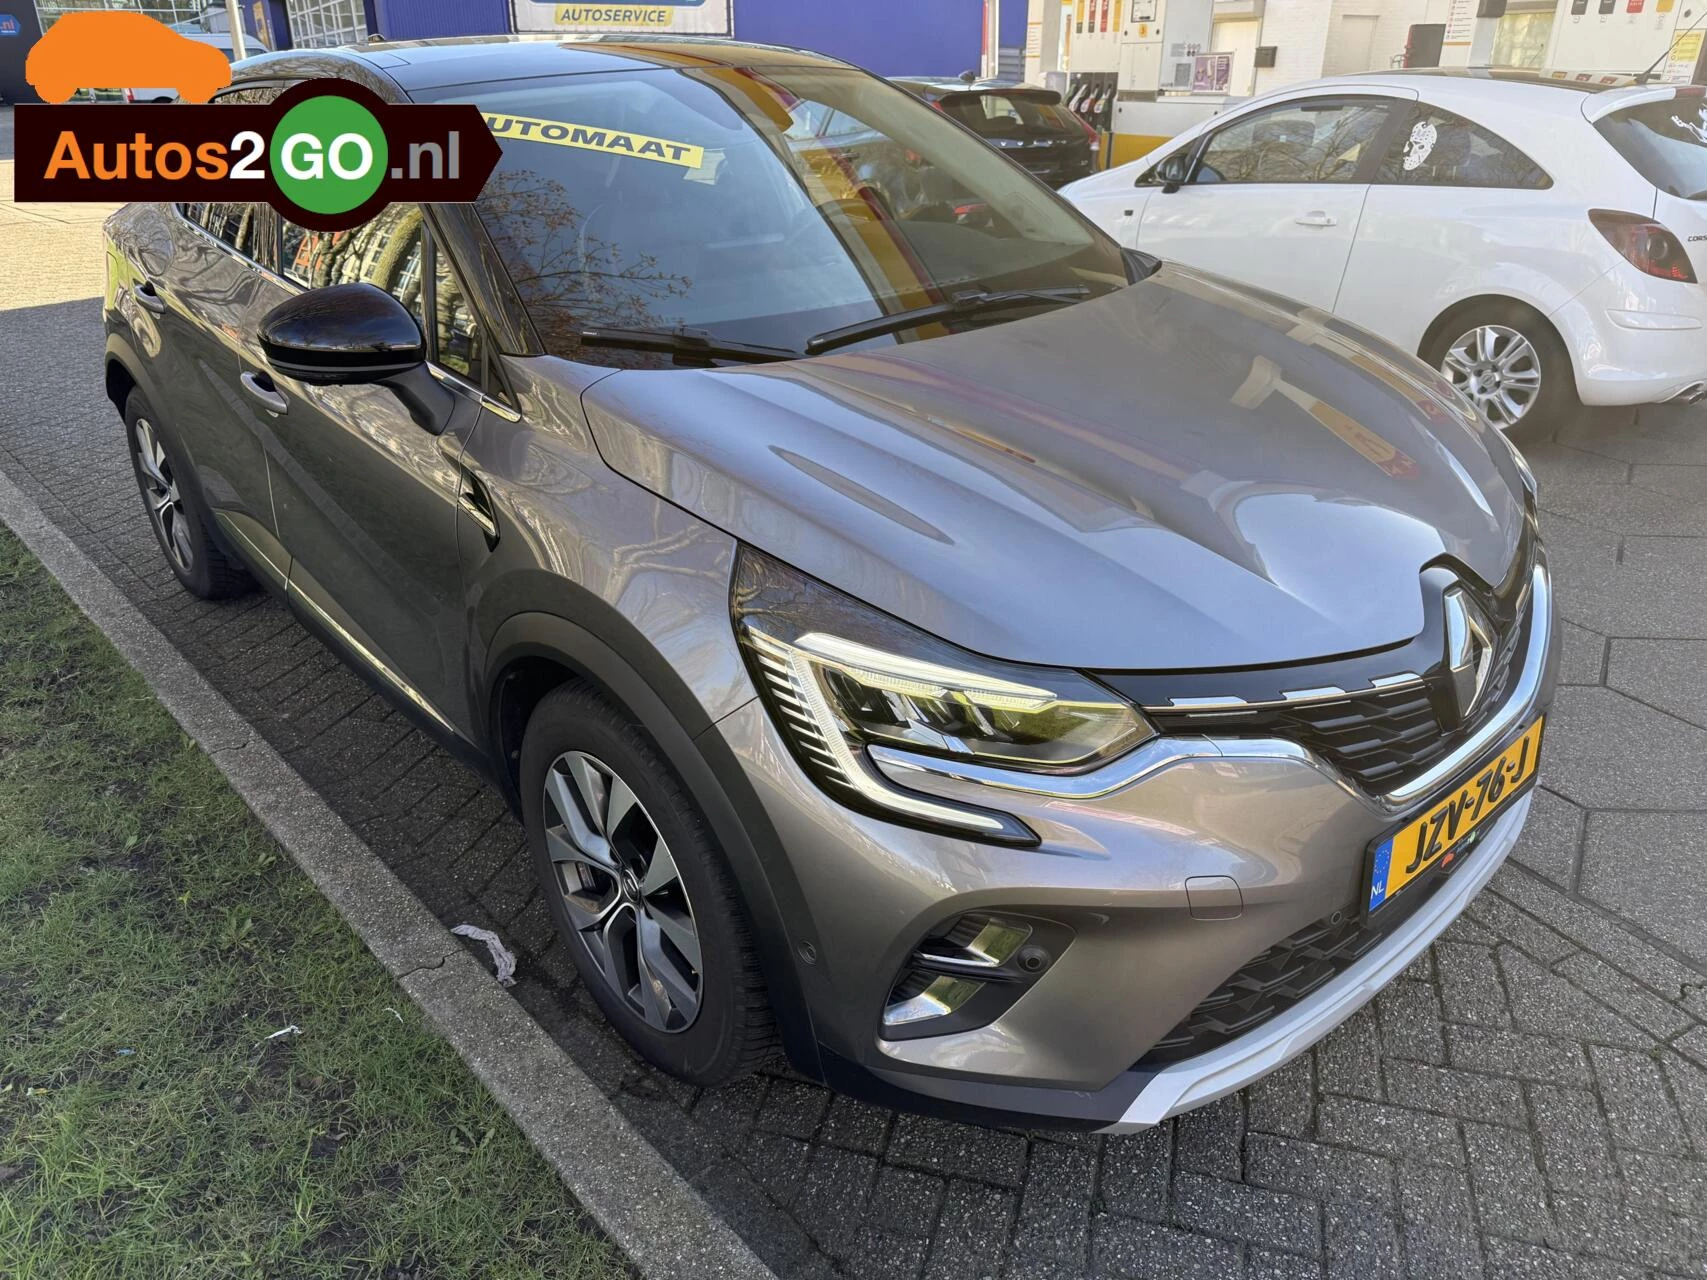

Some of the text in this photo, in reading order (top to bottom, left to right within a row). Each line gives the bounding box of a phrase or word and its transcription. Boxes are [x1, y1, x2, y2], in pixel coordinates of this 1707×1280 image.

[560, 8, 667, 24] AUTOSERVICE
[486, 116, 691, 162] UTOMAAT
[1405, 736, 1530, 875] JZV-76-J
[1370, 880, 1385, 900] NL
